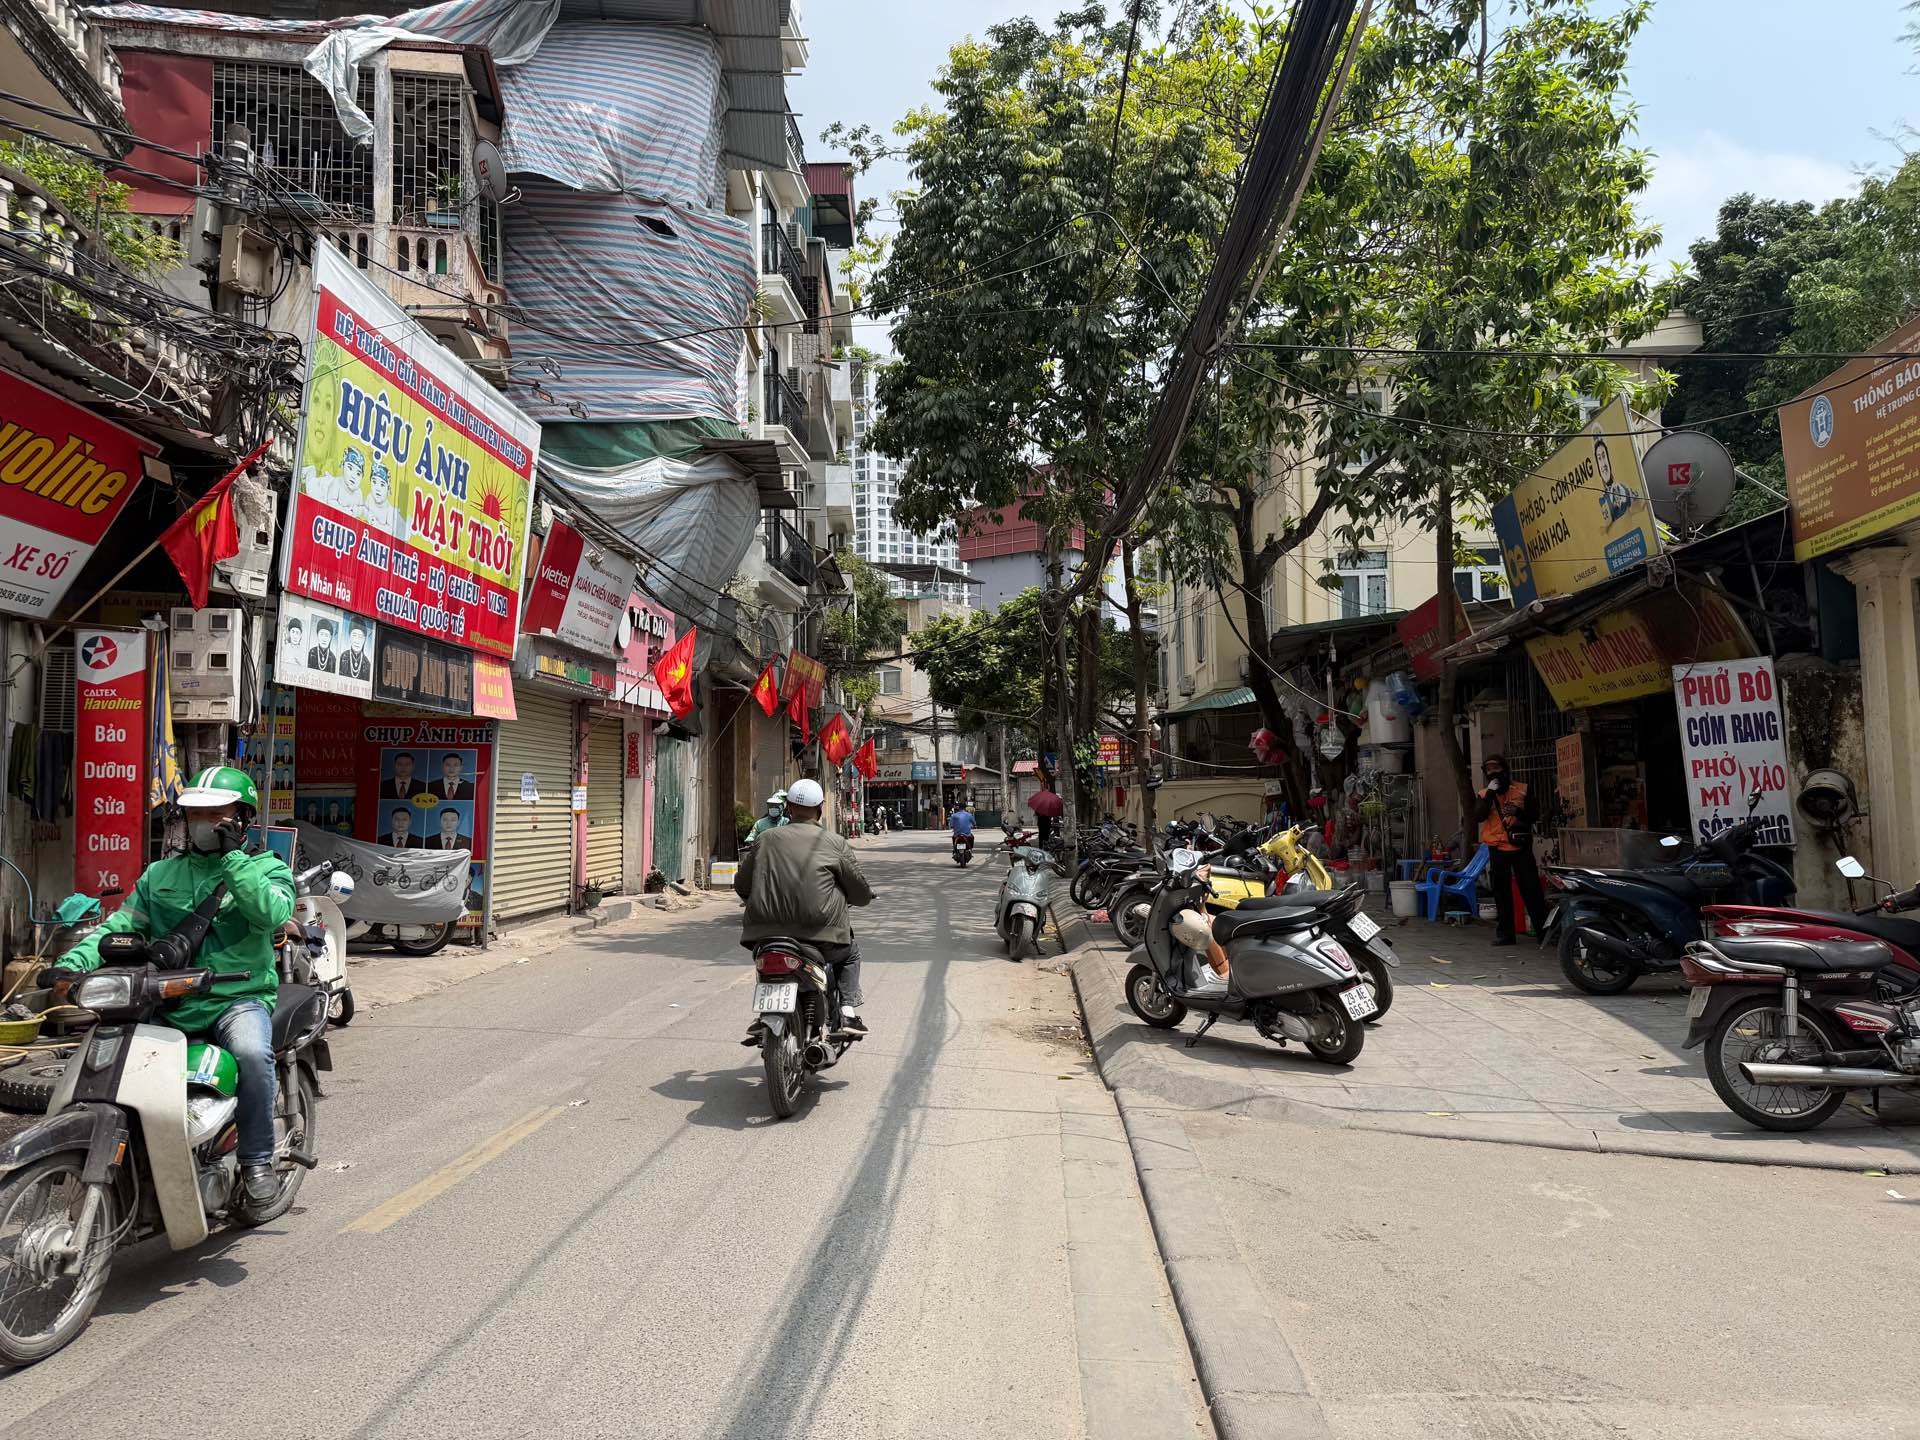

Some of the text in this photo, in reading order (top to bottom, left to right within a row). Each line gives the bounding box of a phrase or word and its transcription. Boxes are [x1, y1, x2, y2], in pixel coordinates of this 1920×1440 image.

[335, 310, 526, 469] HỆ THỐNG CỬA HÀNG ẢNH CHUYÊN NGHIỆP
[1853, 380, 1895, 415] THÔNG
[1887, 392, 1915, 416] TRUNG
[338, 380, 470, 500] HIỆU ẢNH
[0, 416, 129, 517] voline
[1569, 457, 1594, 492] RANG
[411, 490, 514, 577] MẶT TRỜI
[1527, 529, 1551, 562] NHÂN
[3, 542, 78, 580] XE SỐ
[313, 515, 356, 559] CHỤP
[358, 530, 390, 572] ẢNH
[393, 549, 419, 584] THẺ
[428, 563, 446, 599] HỘ
[448, 572, 480, 607] CHIẾU
[488, 589, 509, 617] VISA
[298, 567, 352, 603] 14 Nhân Hòa
[541, 564, 571, 590] viettel
[574, 575, 591, 594] XUÂN
[376, 585, 465, 638] CHUẨN QUỐC TẾ
[633, 607, 651, 634] TRÀ
[83, 689, 117, 697] CALTEX
[1682, 665, 1773, 707] PHỞ BÒ
[83, 697, 142, 711] Havoline
[95, 724, 127, 743] Bảo
[364, 726, 415, 746] CHỤP
[417, 721, 461, 744] ẢNH
[1687, 710, 1779, 747] CƠM RANG
[84, 761, 137, 782] Dưỡng
[1691, 751, 1737, 779] PHỞ
[1747, 759, 1786, 793] XÀO
[93, 797, 125, 816] Sửa
[1700, 784, 1734, 808] MỲ
[88, 833, 131, 852] Chữa
[97, 870, 119, 887] Xe
[759, 998, 789, 1010] 8015
